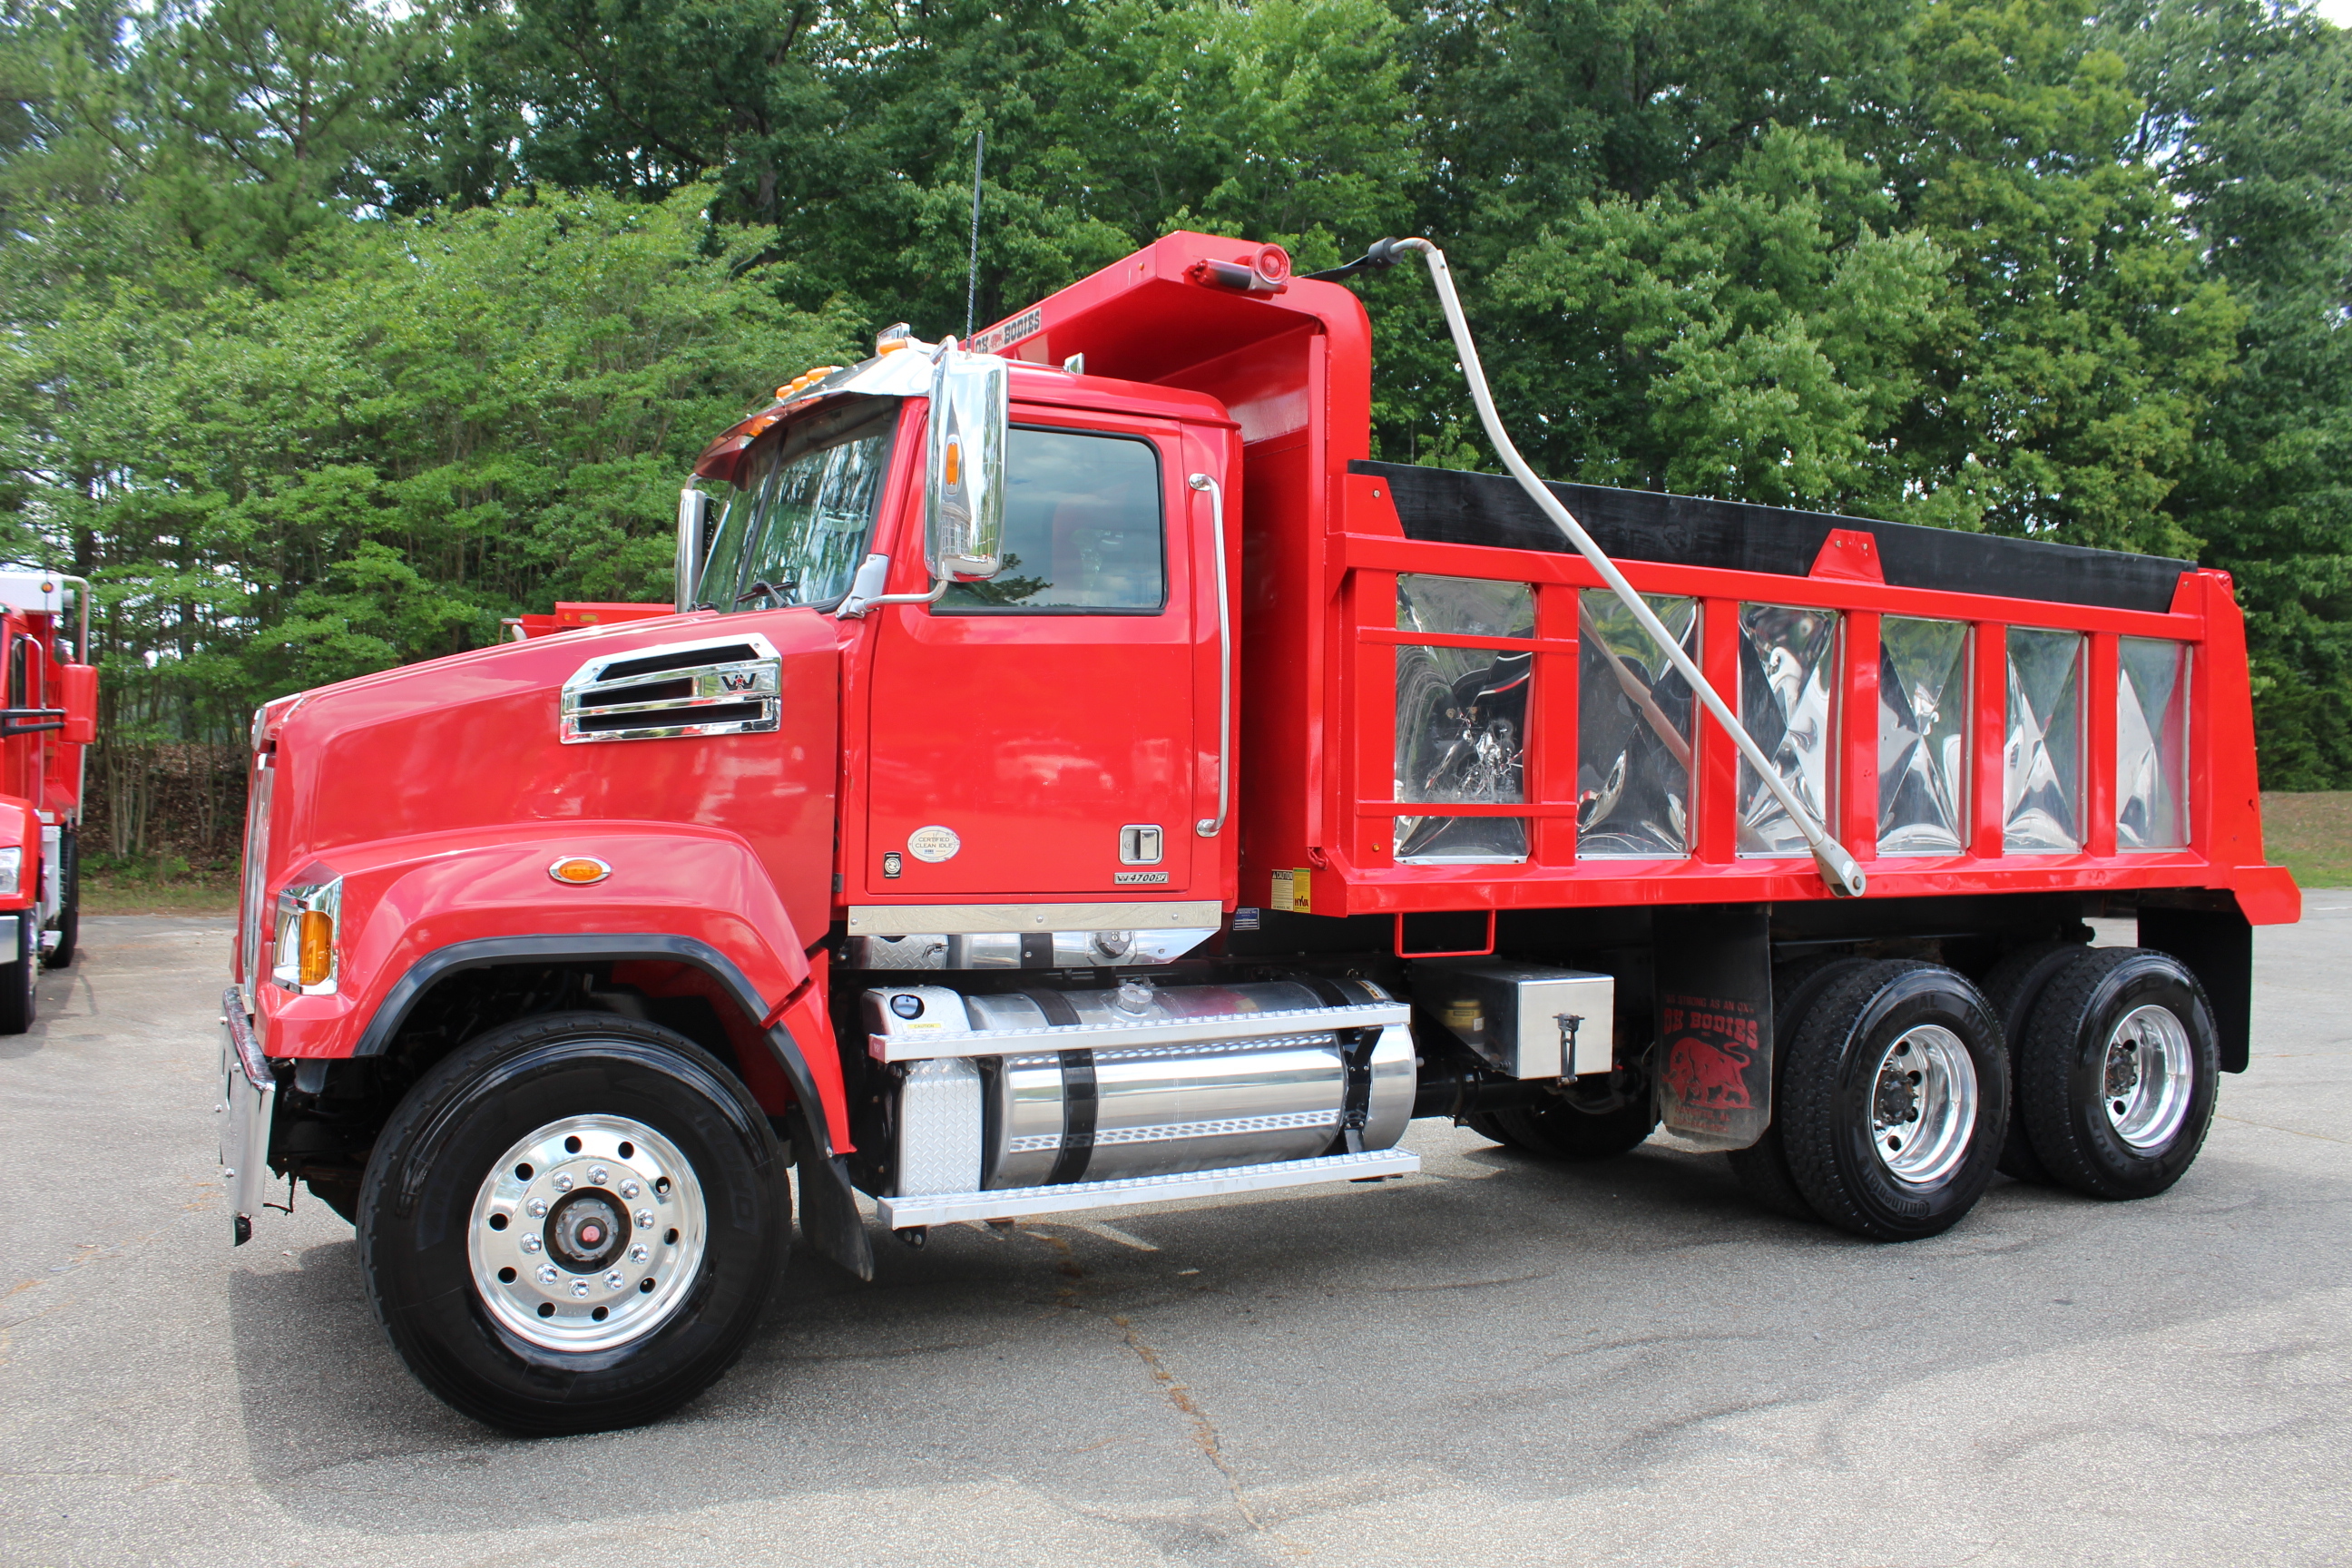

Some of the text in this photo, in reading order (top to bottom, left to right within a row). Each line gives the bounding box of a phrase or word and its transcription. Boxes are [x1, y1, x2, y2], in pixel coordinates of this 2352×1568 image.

[1004, 310, 1040, 344] BODIES
[1276, 871, 1293, 880] CAUTION
[1294, 896, 1309, 907] HYVA
[1678, 995, 1707, 1007] STRONG
[1710, 998, 1720, 1009] AS
[1723, 1000, 1734, 1011] AN
[1663, 1008, 1759, 1051] OX BODIES
